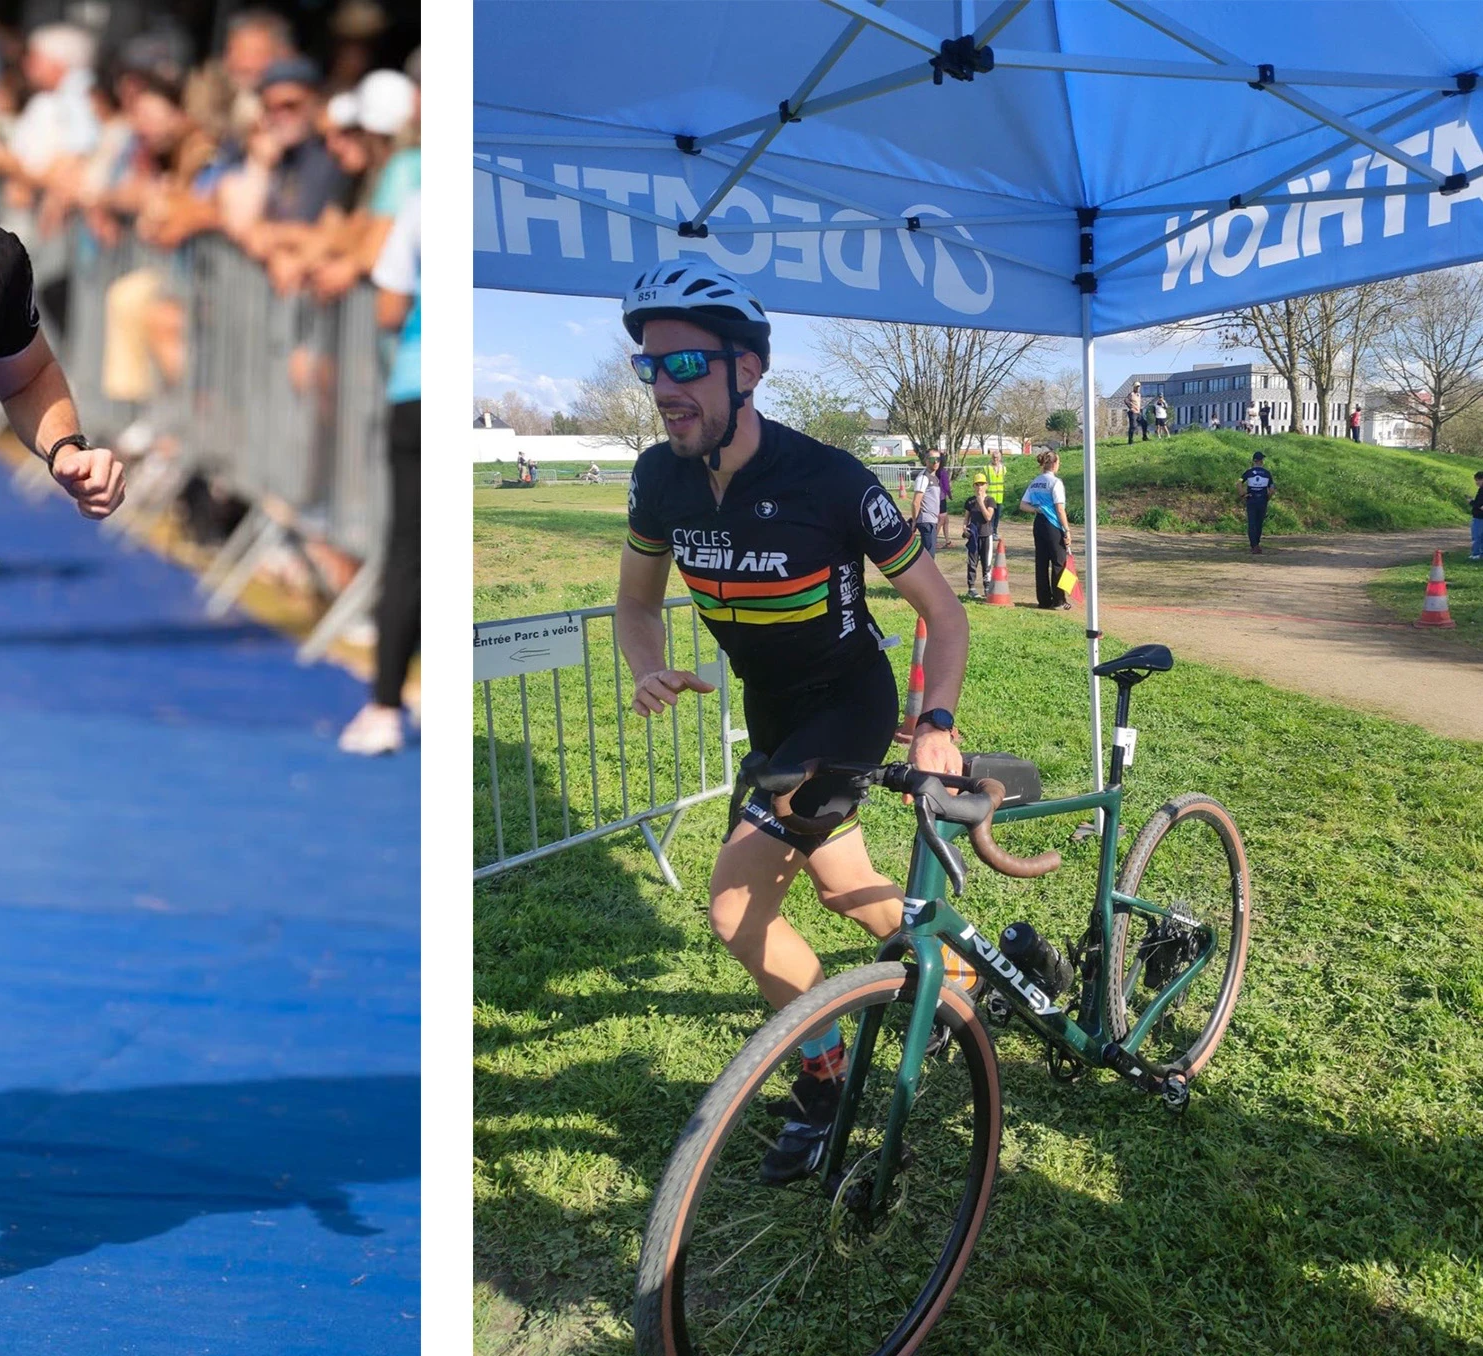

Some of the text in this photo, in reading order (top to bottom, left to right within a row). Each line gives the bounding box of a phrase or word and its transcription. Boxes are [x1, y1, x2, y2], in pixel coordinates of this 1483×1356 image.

[638, 291, 657, 301] 851
[672, 528, 732, 547] CYCLES
[673, 544, 789, 578] PLEIN AIR
[473, 625, 579, 648] Entrée Parc à vélos
[960, 924, 1062, 1016] RIDLEY
